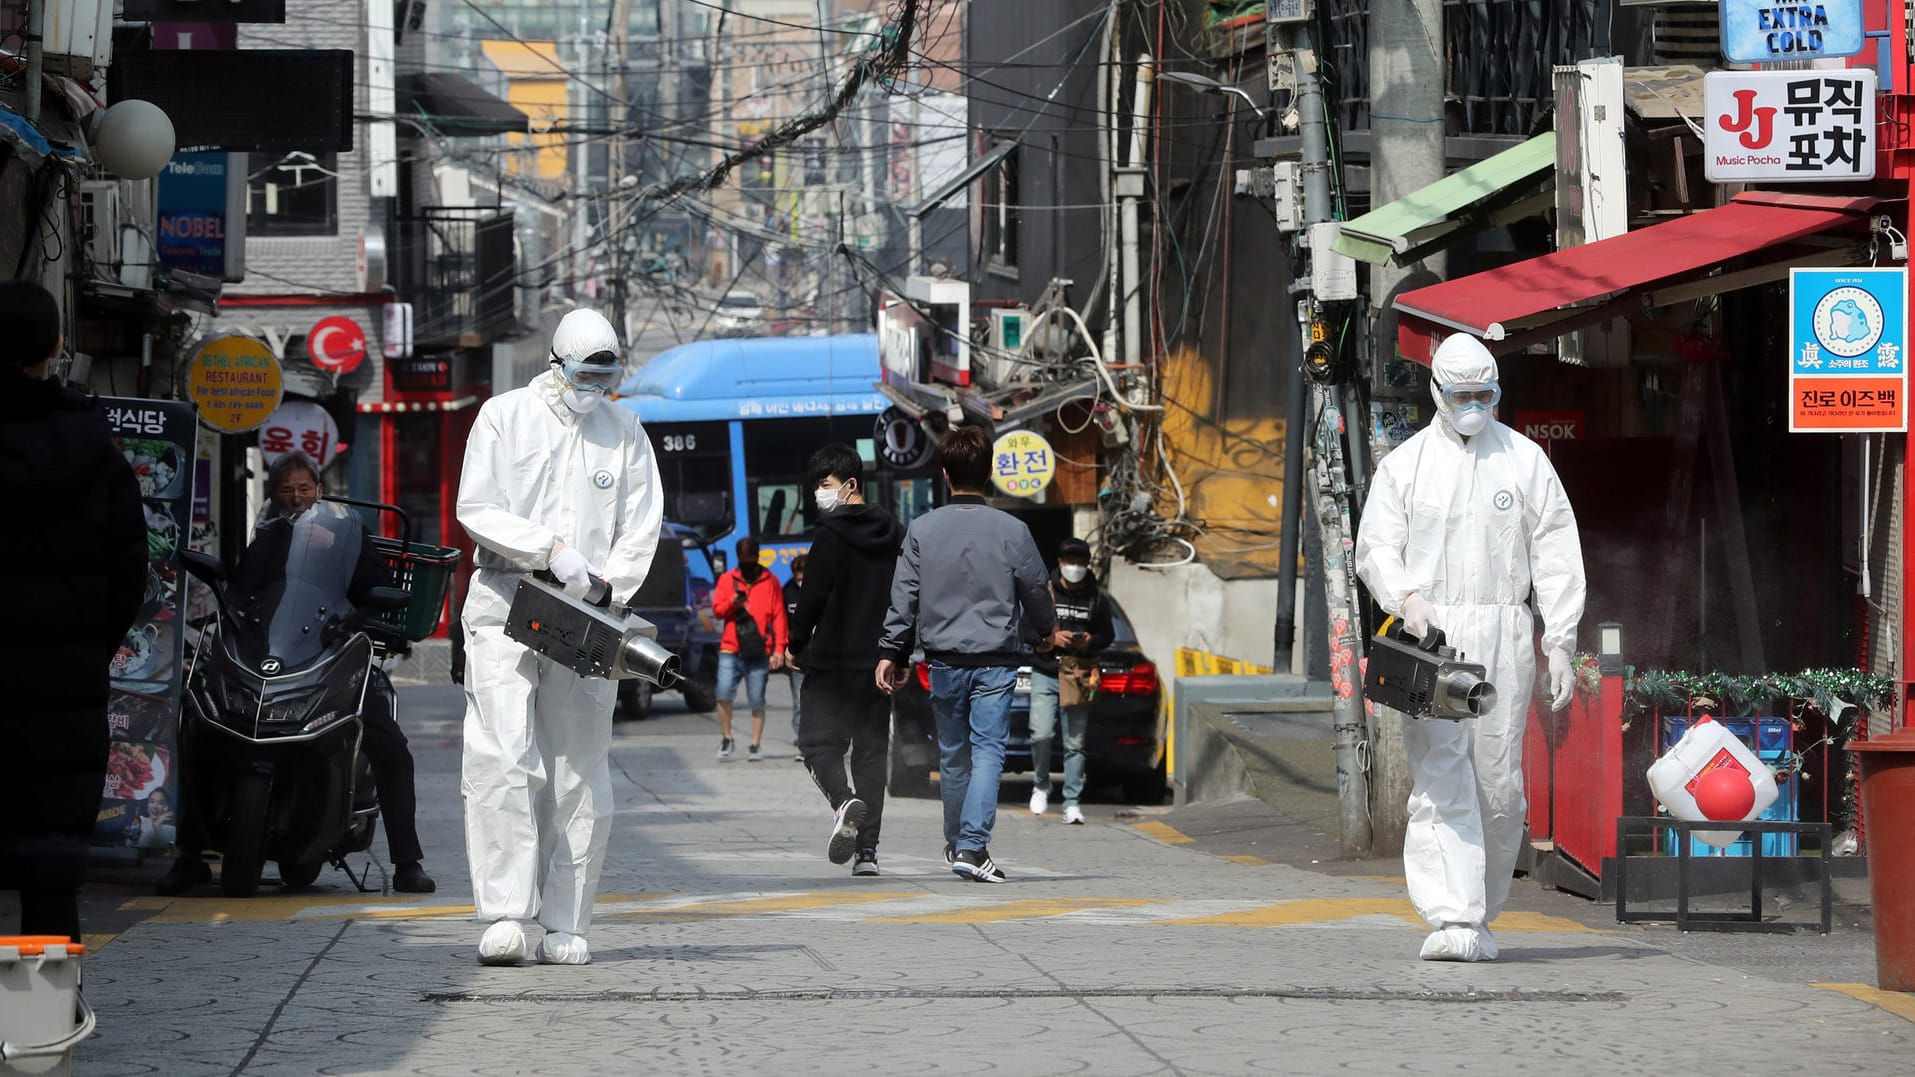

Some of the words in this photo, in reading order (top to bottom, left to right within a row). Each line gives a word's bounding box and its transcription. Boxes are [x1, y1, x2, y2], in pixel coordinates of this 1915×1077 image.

[1758, 5, 1829, 30] EXTRA
[1766, 30, 1823, 53] COLD
[1783, 78, 1864, 127] 뮤직
[1718, 89, 1778, 150] JJ
[1785, 126, 1867, 173] 포차
[1716, 155, 1746, 166] Music
[1747, 155, 1781, 165] Pocha
[160, 216, 225, 239] NOBEL
[203, 355, 232, 368] BETHEL
[235, 355, 269, 368] AFRICAN
[1828, 359, 1852, 368] 소주의
[1853, 359, 1869, 368] 원조
[206, 372, 267, 384] RESTAURANT
[1801, 390, 1837, 409] 진로
[1840, 389, 1874, 408] 이즈
[1878, 389, 1896, 408] 백
[1525, 424, 1576, 439] NSOK
[663, 434, 696, 452] 386
[996, 449, 1048, 477] 환전
